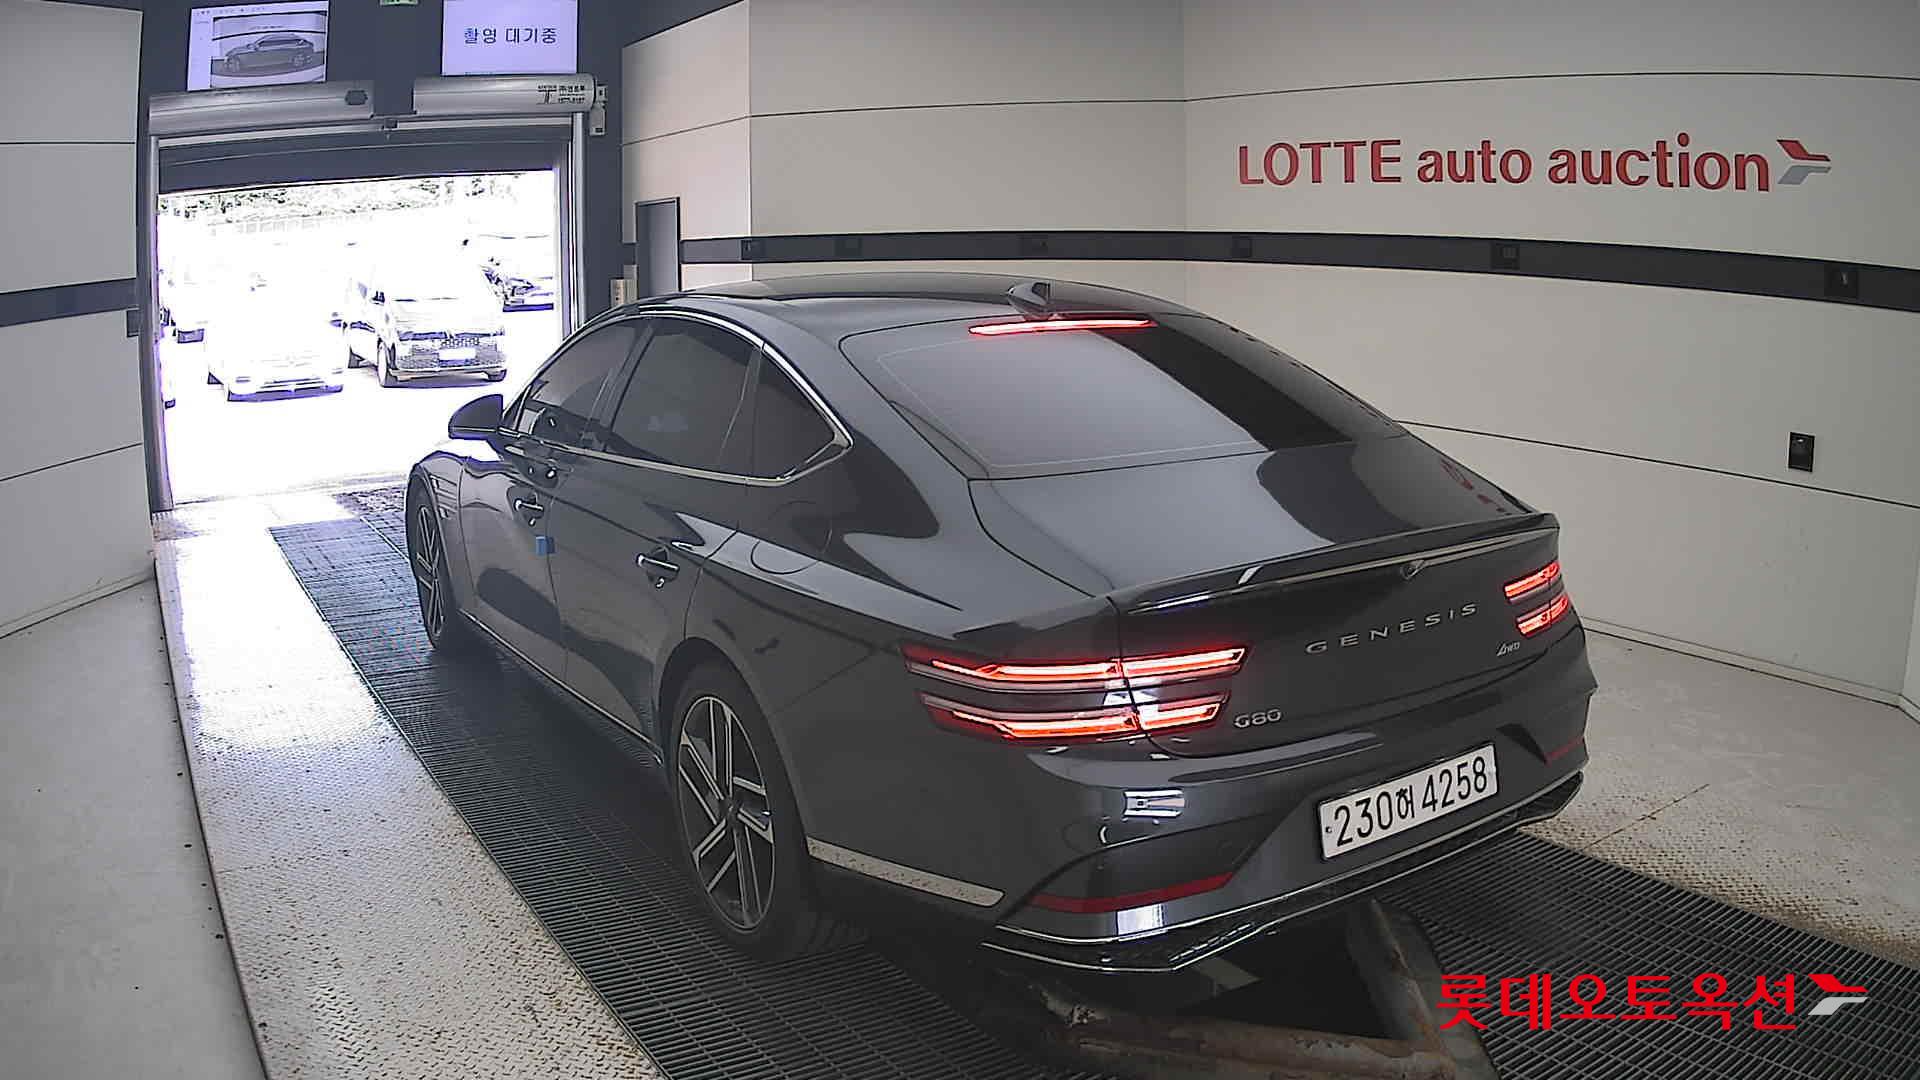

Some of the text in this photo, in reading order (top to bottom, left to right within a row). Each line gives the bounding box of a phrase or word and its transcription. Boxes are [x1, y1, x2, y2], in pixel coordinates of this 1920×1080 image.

[464, 28, 557, 44] 촬영 대기중
[1239, 133, 1770, 192] LOTTE auto auction
[1306, 603, 1478, 654] GENESIS
[1234, 709, 1282, 729] G80
[1334, 756, 1488, 847] 230허 4258
